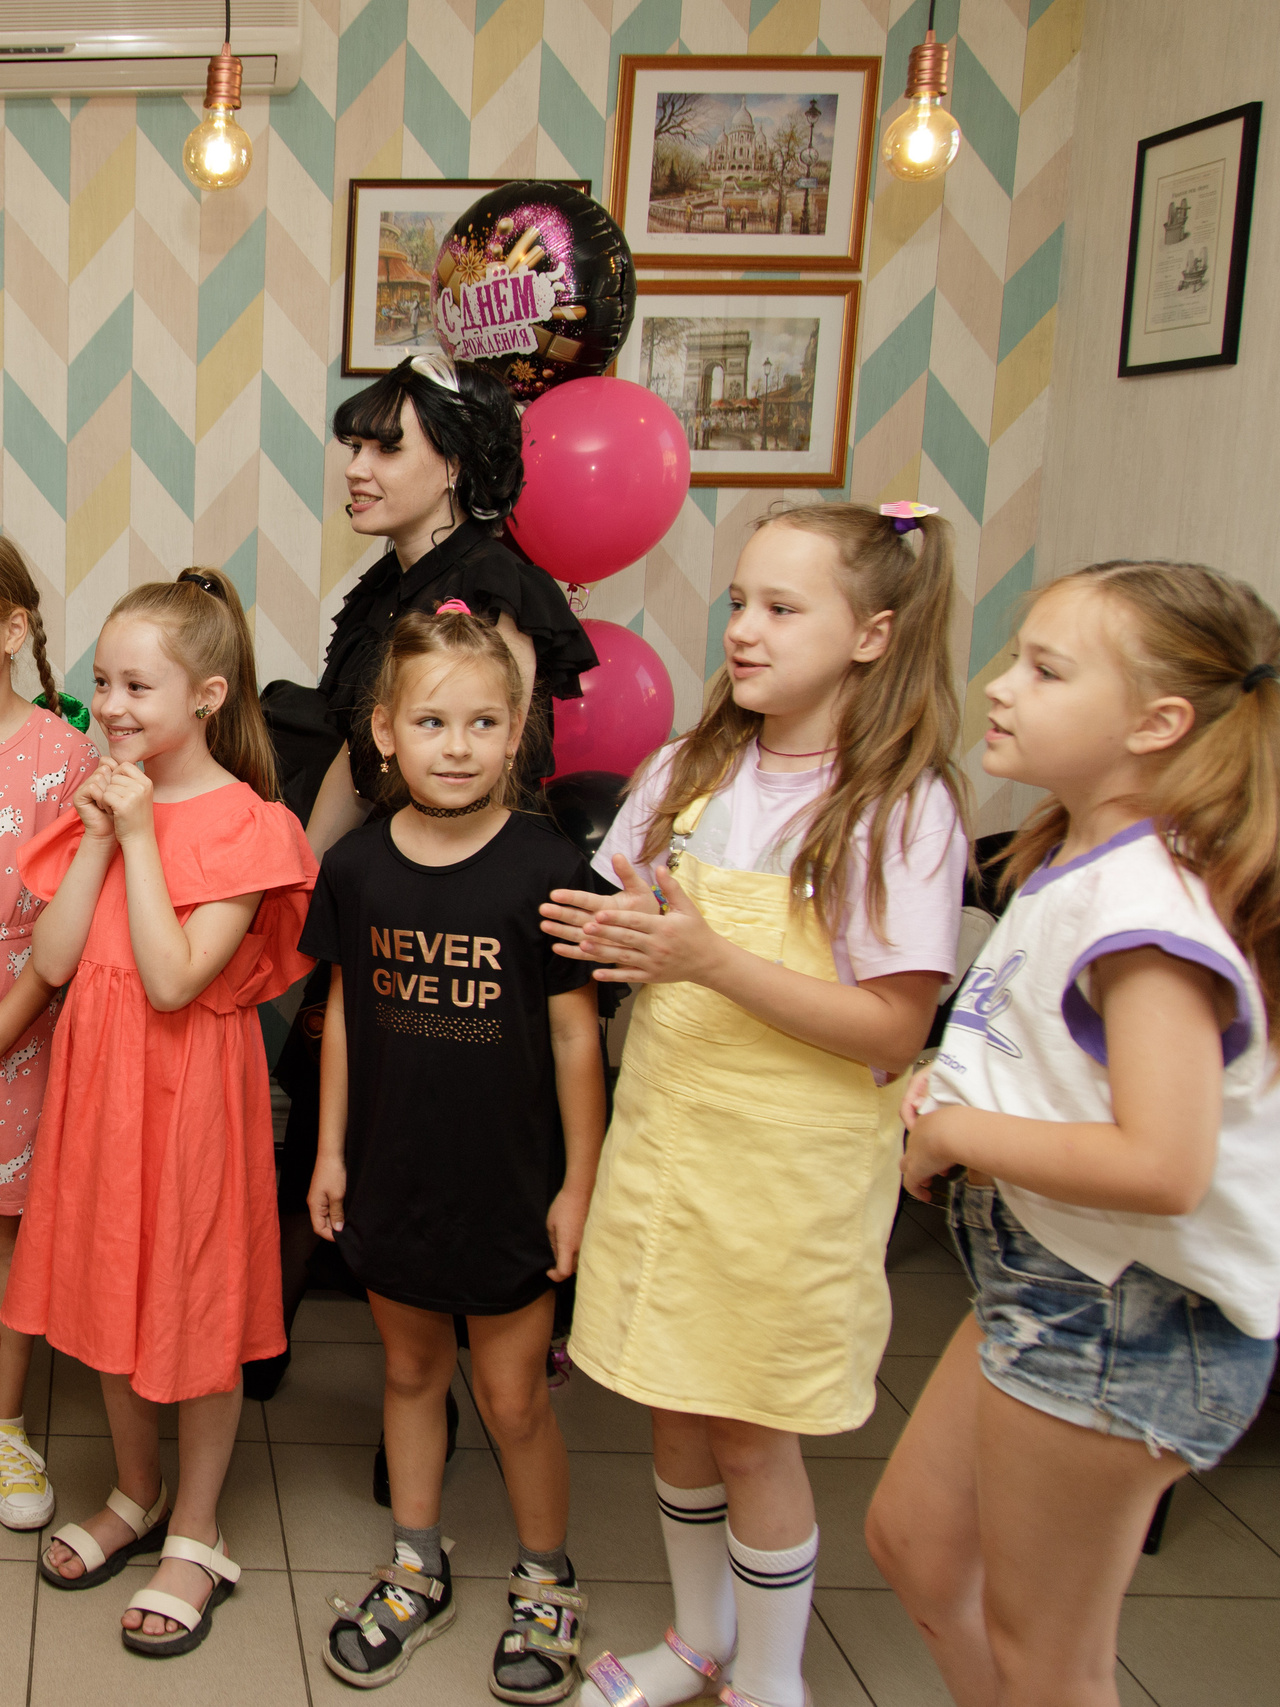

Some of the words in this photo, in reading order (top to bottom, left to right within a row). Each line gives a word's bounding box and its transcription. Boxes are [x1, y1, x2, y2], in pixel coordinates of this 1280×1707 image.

[442, 291, 456, 334] С
[461, 269, 539, 338] ДНЁМ
[461, 328, 531, 358] РОЖДЕНИЯ
[370, 926, 502, 970] NEVER
[372, 968, 439, 1005] GIVE
[451, 978, 502, 1009] UP
